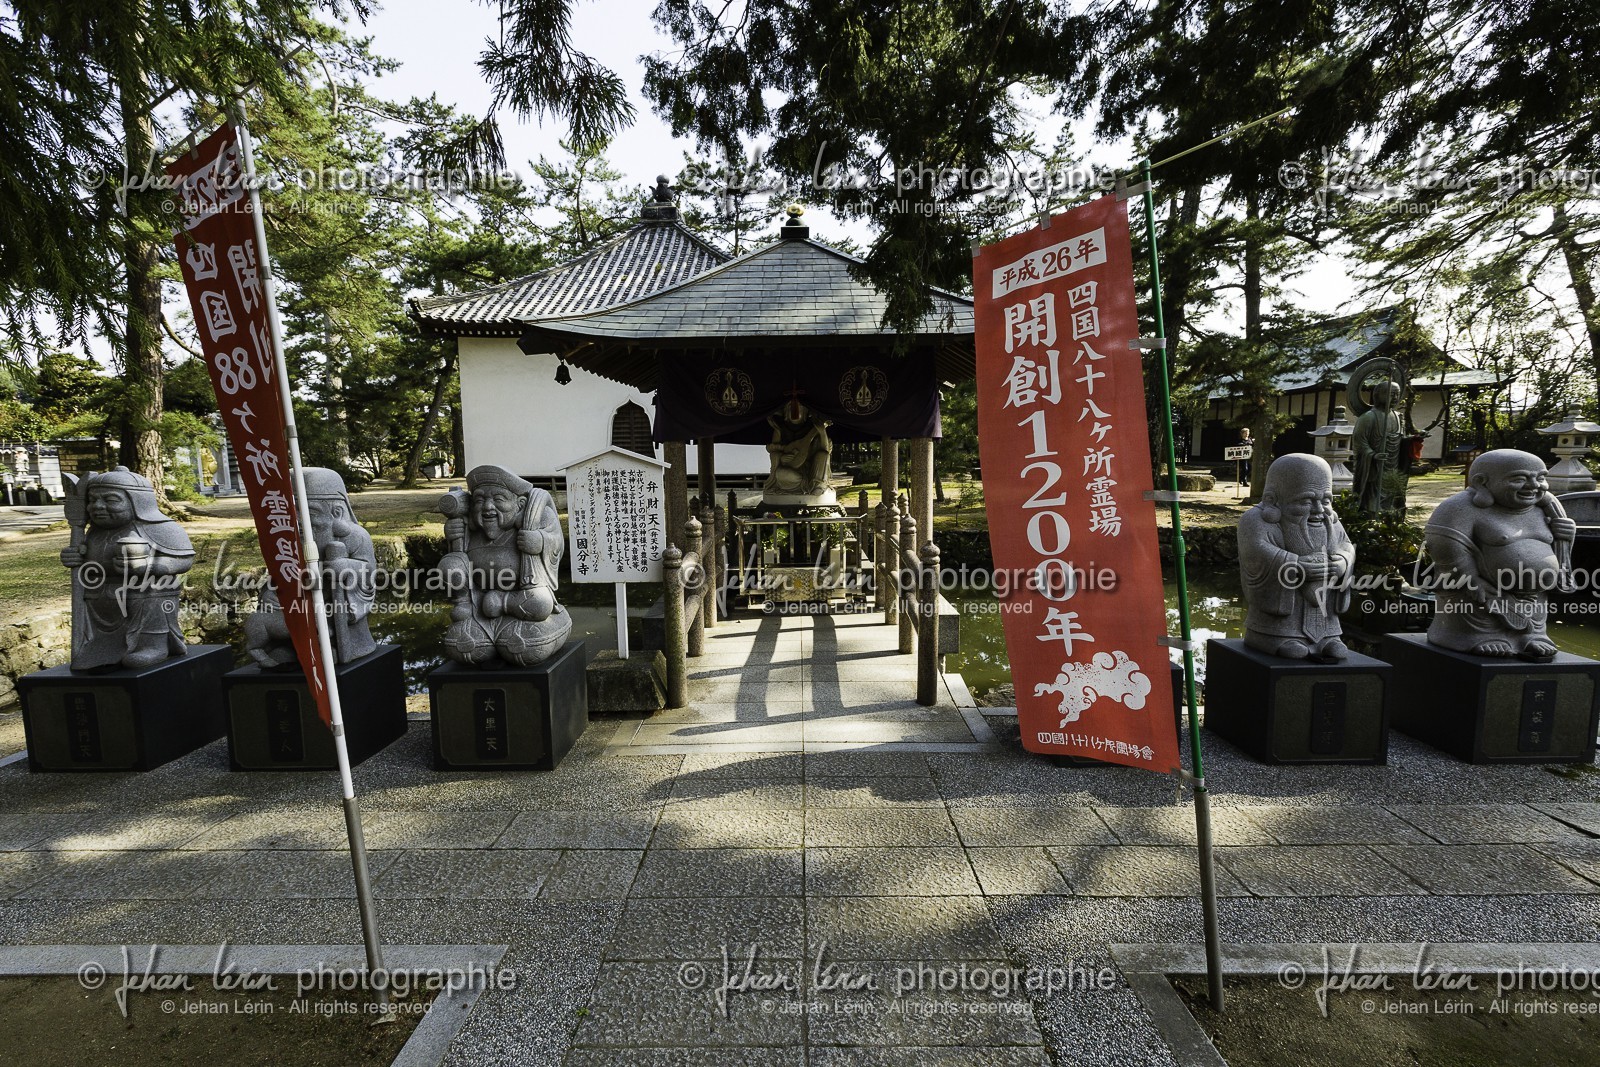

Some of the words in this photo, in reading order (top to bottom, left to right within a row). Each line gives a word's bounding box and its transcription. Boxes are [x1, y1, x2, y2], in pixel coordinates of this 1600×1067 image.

[999, 238, 1100, 290] 平成26年
[1067, 280, 1122, 537] 四国八十八ヶ所霊場
[1001, 292, 1095, 657] 開創1200年
[577, 538, 590, 576] 國分寺
[484, 697, 498, 751] 大黒天
